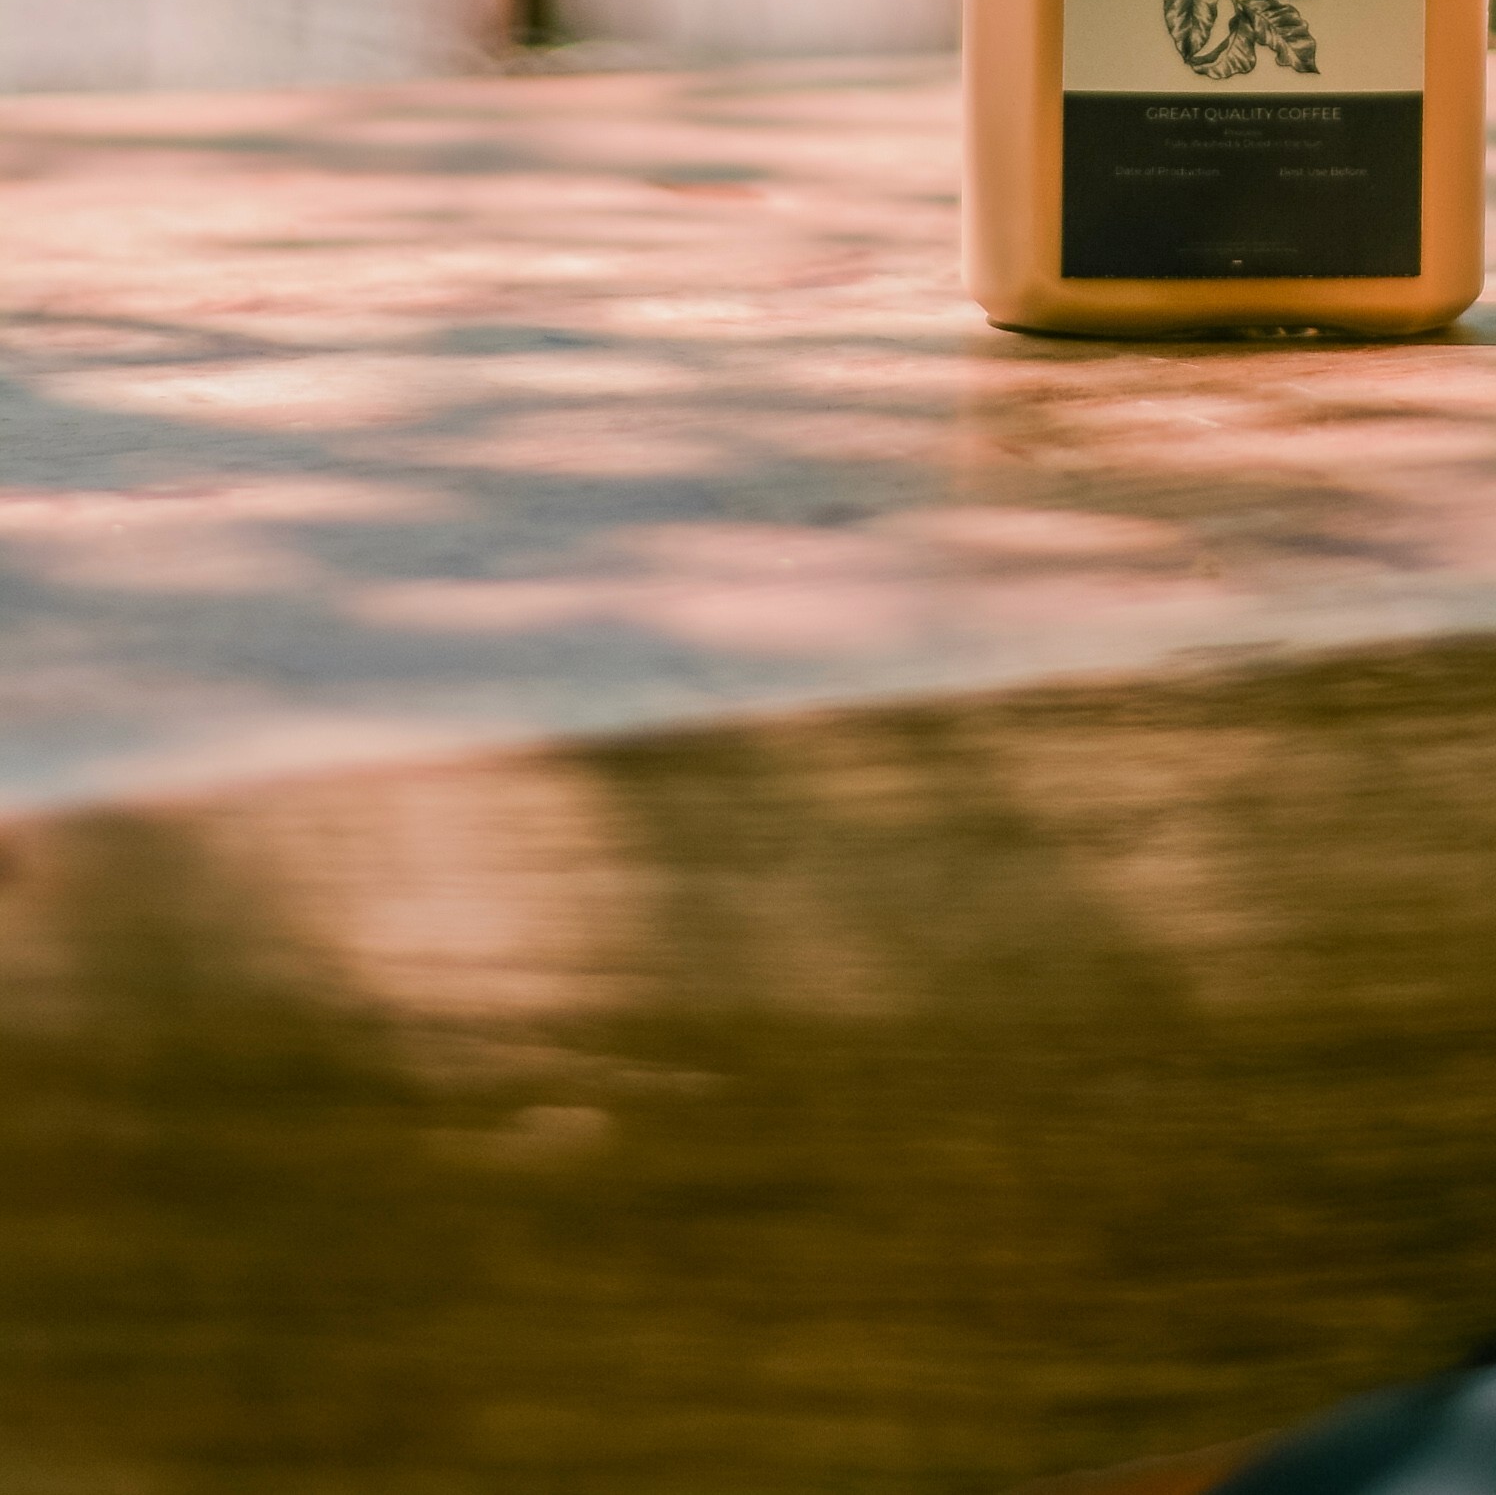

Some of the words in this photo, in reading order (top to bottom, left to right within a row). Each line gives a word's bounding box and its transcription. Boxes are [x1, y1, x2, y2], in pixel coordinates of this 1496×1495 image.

[1146, 107, 1200, 121] GREAT
[1204, 107, 1274, 122] QUALITY
[1278, 107, 1342, 121] COFFEE
[1115, 166, 1141, 176] Date
[1144, 166, 1155, 176] of
